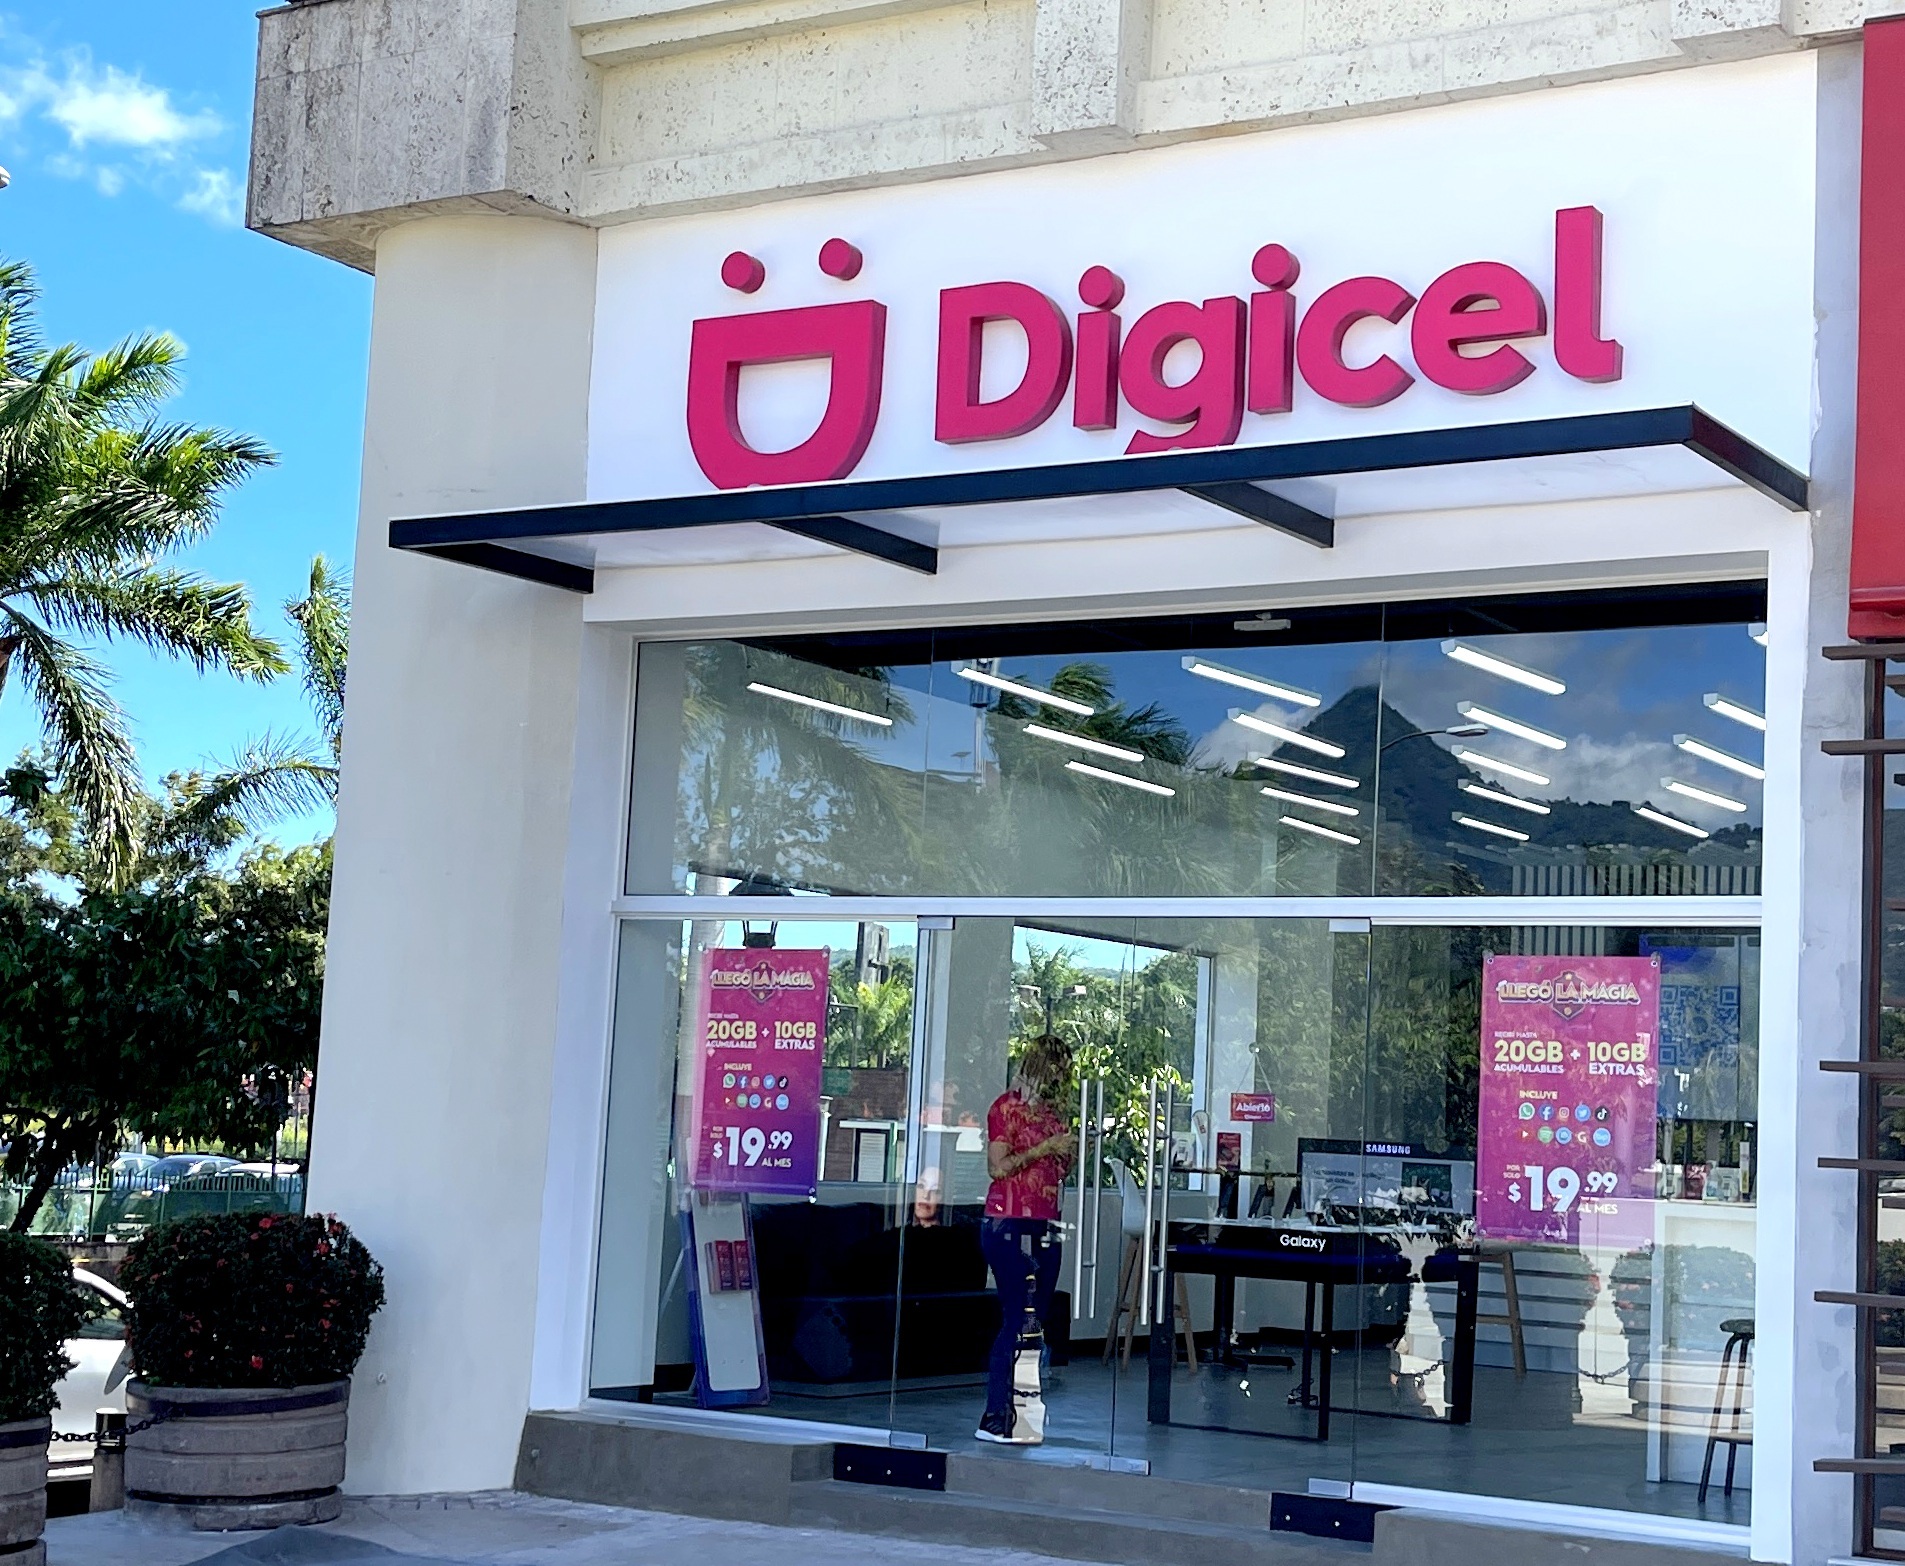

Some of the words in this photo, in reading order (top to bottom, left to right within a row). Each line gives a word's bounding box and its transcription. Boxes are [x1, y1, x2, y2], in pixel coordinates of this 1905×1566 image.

[935, 206, 1622, 453] Digicel
[753, 970, 770, 988] LA
[771, 970, 814, 989] MAGIA
[1556, 982, 1580, 1004] LA
[1581, 982, 1641, 1005] MAGIA
[706, 1020, 757, 1040] 20GB
[775, 1021, 816, 1039] 10GB
[775, 1039, 815, 1050] EXTRAS
[1494, 1039, 1563, 1063] 20GB
[1587, 1041, 1646, 1063] 10GB
[1494, 1063, 1564, 1074] ACUMULABLES
[1589, 1063, 1645, 1076] EXTRAS
[1519, 1090, 1557, 1100] INCLUYE
[1366, 1144, 1411, 1155] SAMSUNG
[761, 1157, 773, 1167] AL
[774, 1158, 792, 1168] MES
[1576, 1202, 1592, 1213] AL
[1594, 1203, 1619, 1215] MES
[1280, 1233, 1326, 1252] Galaxy
